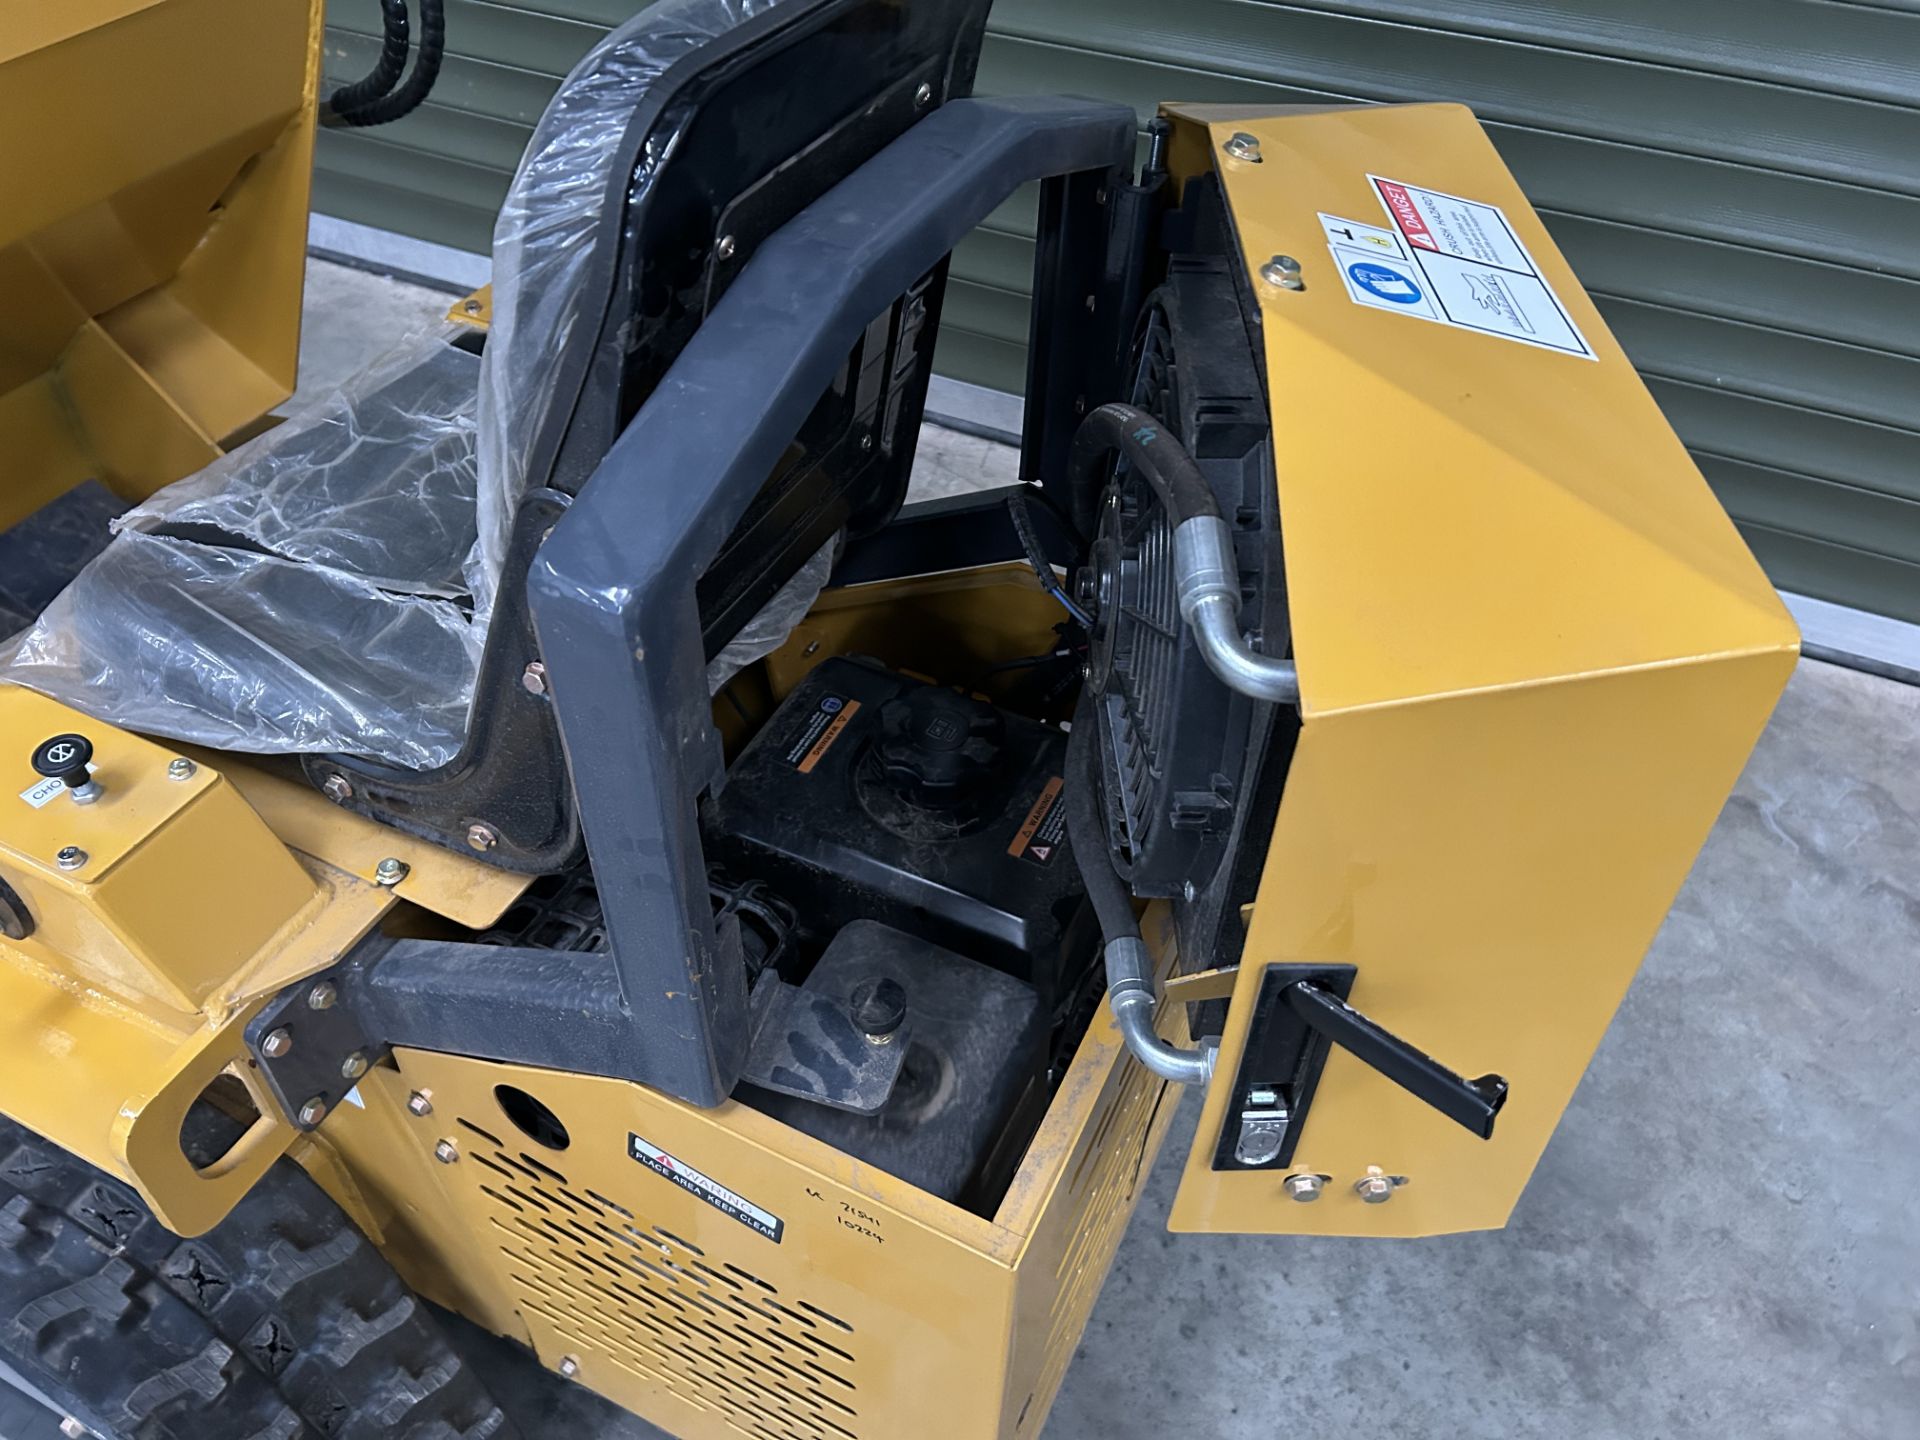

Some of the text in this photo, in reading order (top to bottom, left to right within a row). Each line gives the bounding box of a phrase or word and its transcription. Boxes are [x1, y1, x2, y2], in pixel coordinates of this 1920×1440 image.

[813, 727, 838, 755] WARNING
[32, 777, 63, 800] CHO
[1030, 794, 1053, 826] WARNING
[636, 1152, 775, 1238] PLACE AREA KEEP CLEAR
[684, 1168, 752, 1213] WARING
